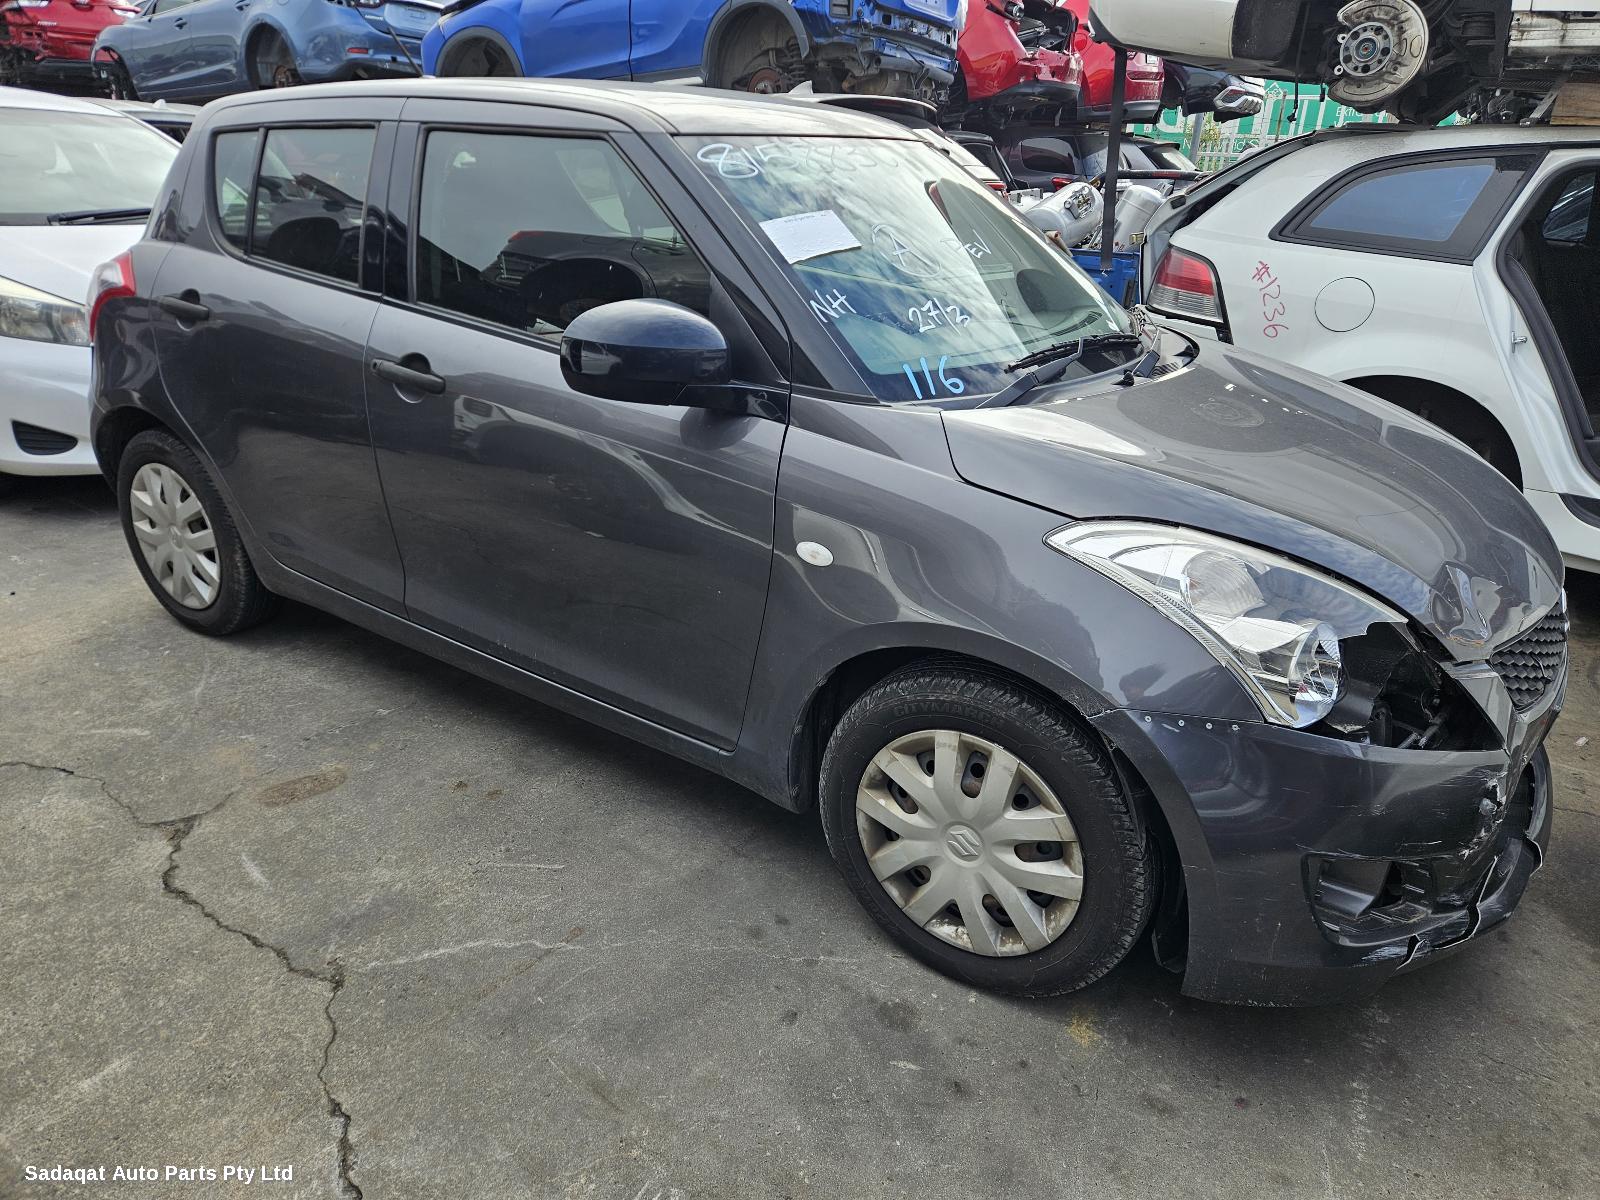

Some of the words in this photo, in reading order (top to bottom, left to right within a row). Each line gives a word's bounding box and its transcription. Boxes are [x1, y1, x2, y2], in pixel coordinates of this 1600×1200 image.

[809, 288, 857, 323] NH
[1251, 260, 1289, 338] #1236
[902, 355, 965, 400] 116
